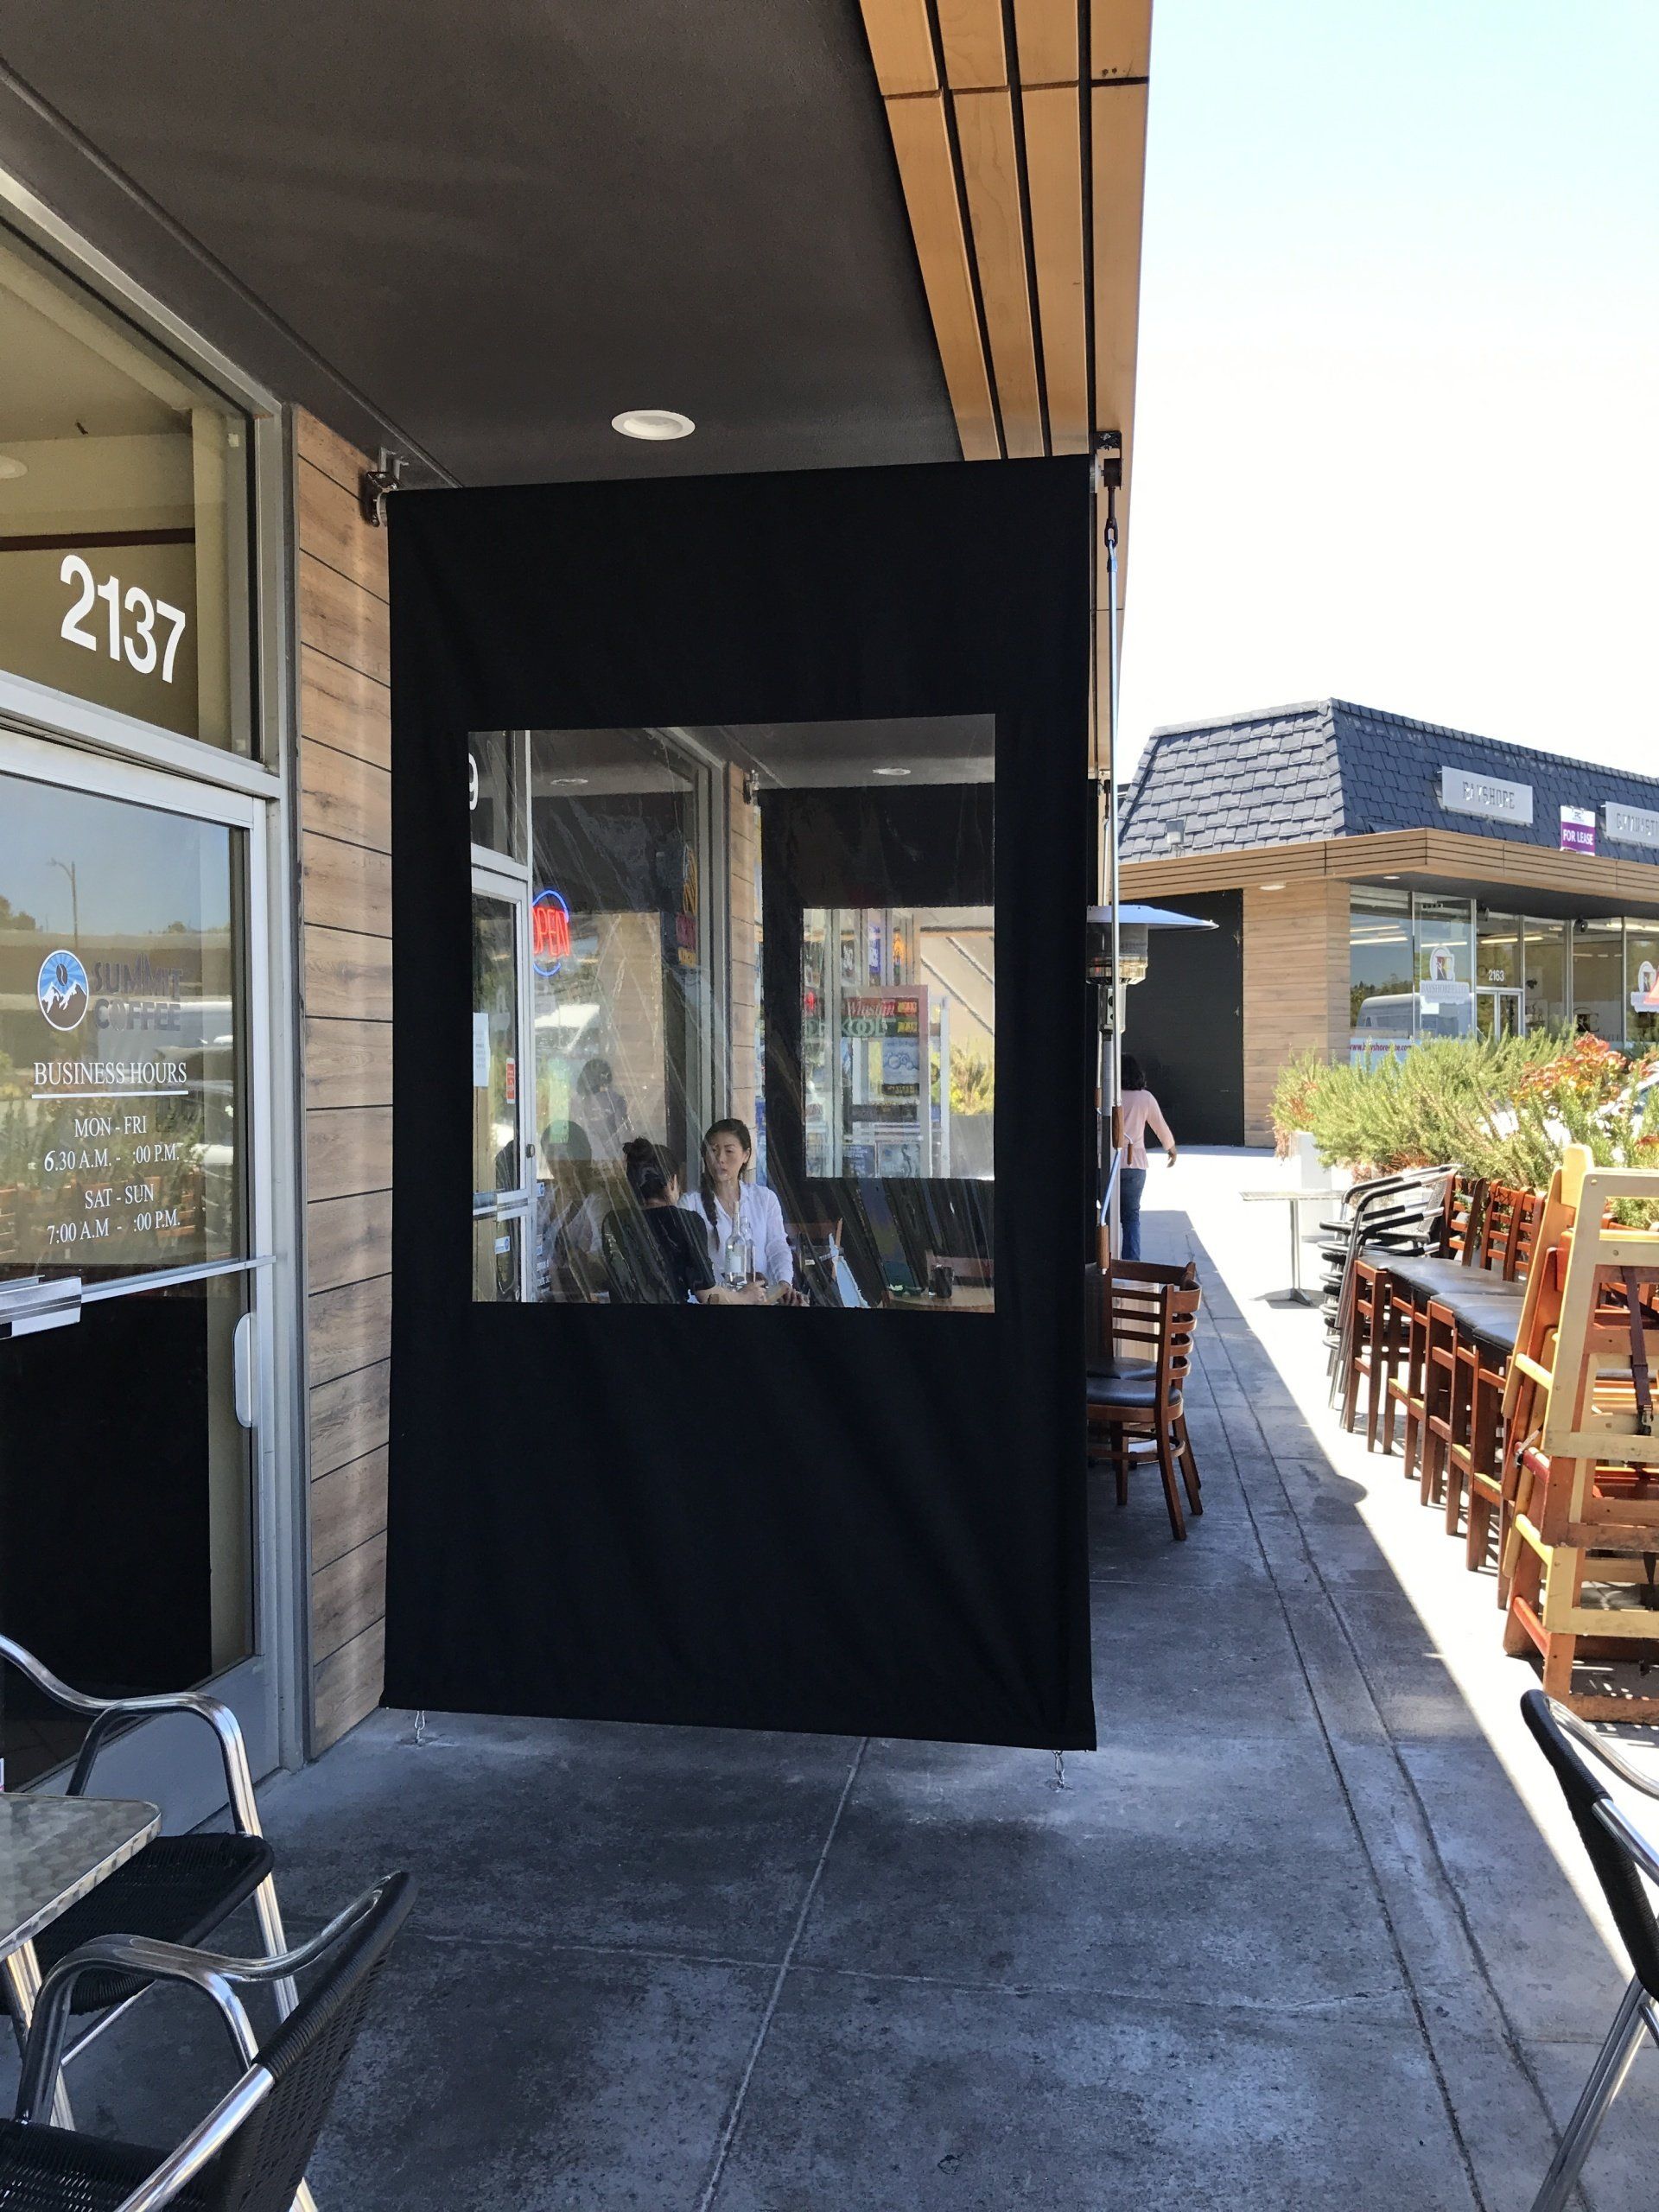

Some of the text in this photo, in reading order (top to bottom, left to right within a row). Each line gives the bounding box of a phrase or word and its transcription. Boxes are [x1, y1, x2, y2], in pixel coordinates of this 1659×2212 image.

[60, 554, 186, 683] 2137
[1562, 829, 1594, 846] FOR LEASE
[93, 953, 183, 1001] SUMMIT
[1488, 969, 1505, 982] 2163
[94, 998, 181, 1032] COFFEE
[33, 1062, 187, 1085] BUSINESS HOURS
[74, 1117, 112, 1138] MON
[124, 1116, 148, 1135] FRI
[79, 1148, 111, 1169] A.M.
[154, 1143, 180, 1162] P.M.
[85, 1188, 113, 1210] SAT
[124, 1184, 155, 1205] SUN
[47, 1222, 77, 1245] 7:00
[155, 1208, 181, 1229] P.M.
